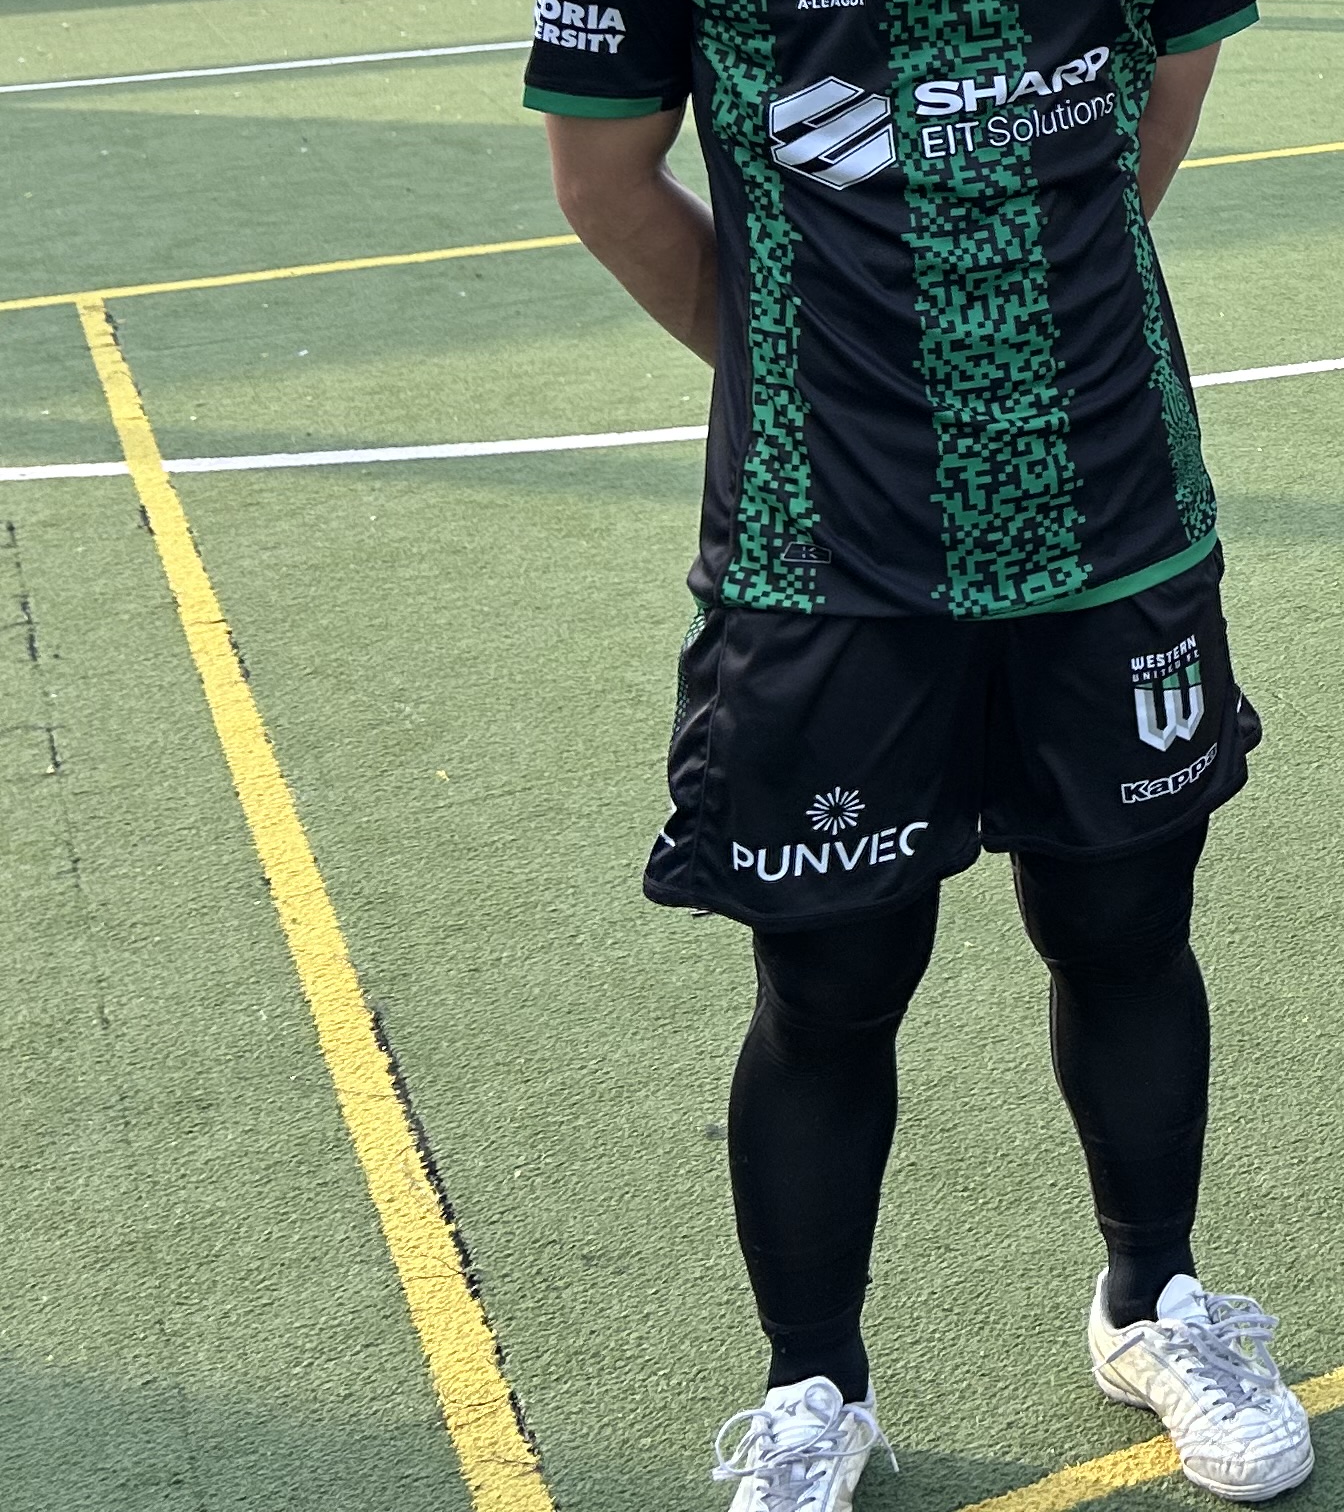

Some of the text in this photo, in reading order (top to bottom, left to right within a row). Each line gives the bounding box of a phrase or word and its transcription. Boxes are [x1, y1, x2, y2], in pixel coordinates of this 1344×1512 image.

[914, 46, 1110, 116] SHARP
[921, 92, 1116, 159] EIT Solutions
[1130, 634, 1197, 671] WESTERN
[1132, 661, 1182, 683] UNITED
[1121, 742, 1218, 804] Kappa
[732, 821, 929, 883] PUNVEC
